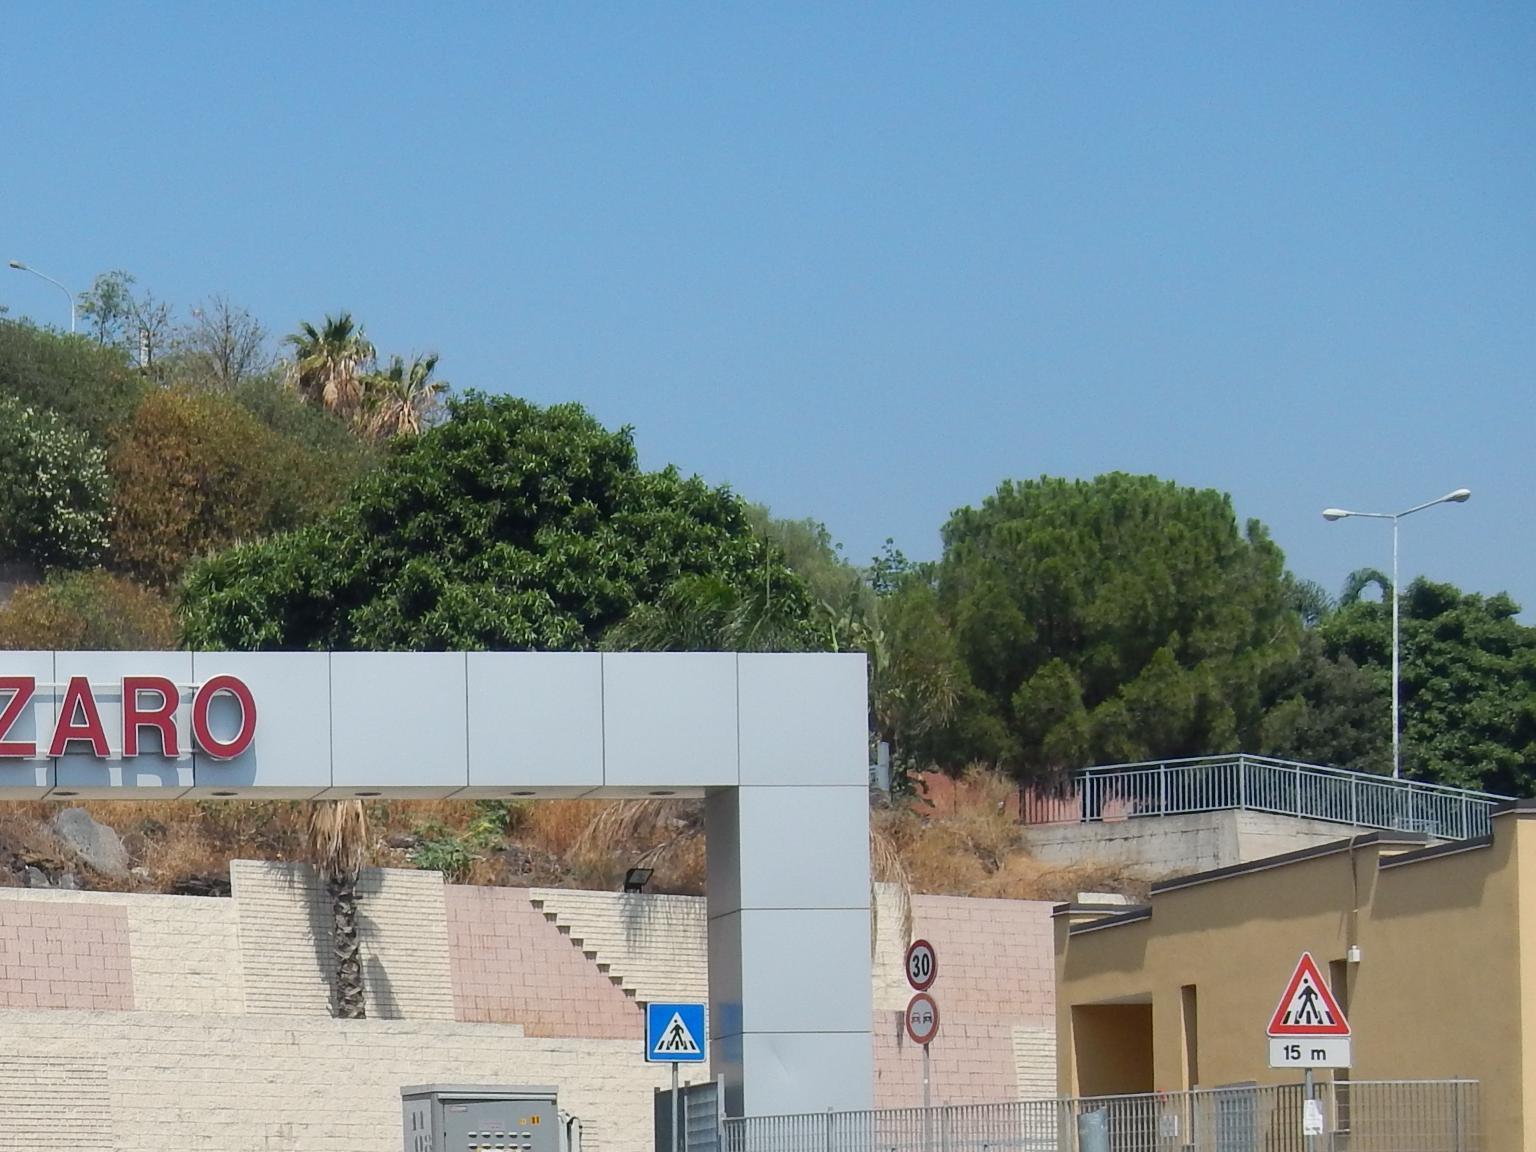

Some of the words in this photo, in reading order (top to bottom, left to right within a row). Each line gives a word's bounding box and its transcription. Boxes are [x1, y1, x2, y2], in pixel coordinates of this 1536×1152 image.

[912, 952, 930, 978] 30
[1283, 1045, 1301, 1061] 15
[1311, 1048, 1327, 1061] m
